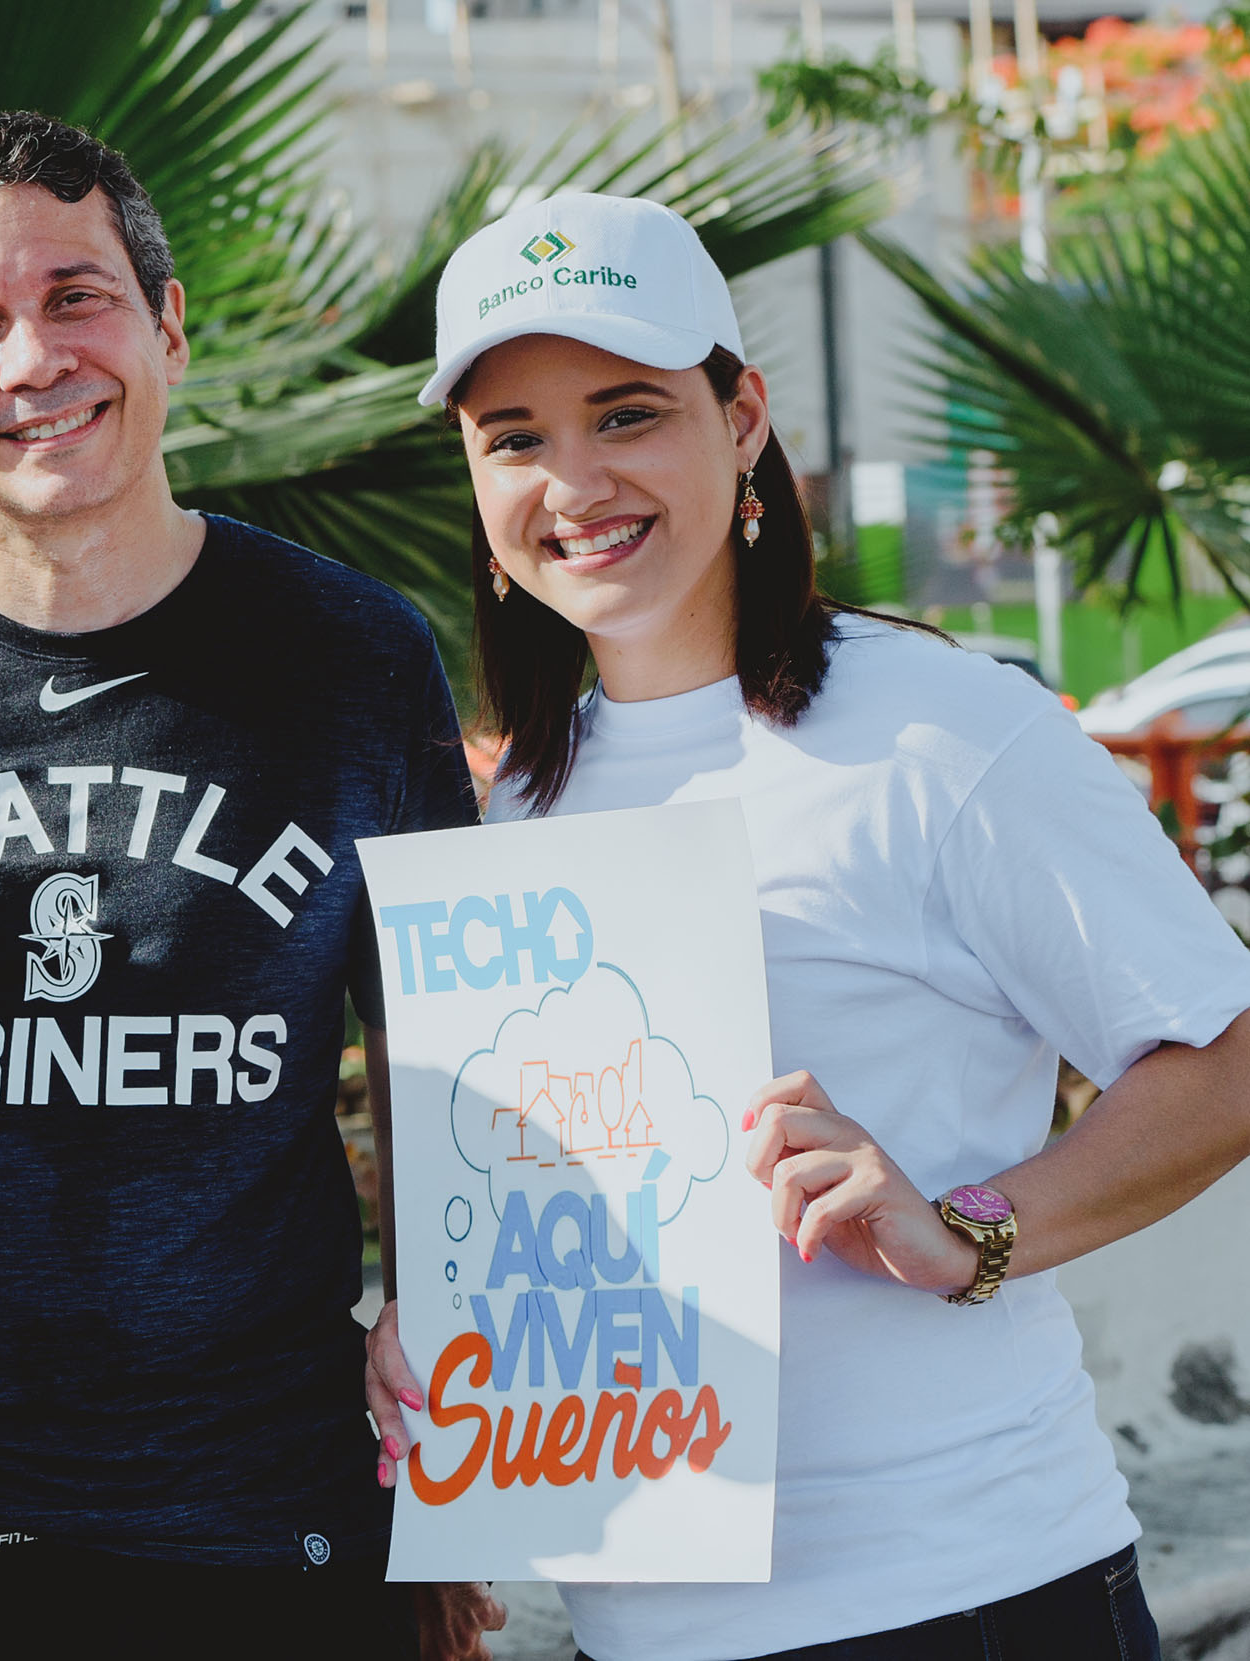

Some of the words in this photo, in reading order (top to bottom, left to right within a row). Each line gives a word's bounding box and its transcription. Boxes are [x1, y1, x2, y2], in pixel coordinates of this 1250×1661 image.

[478, 276, 543, 320] Banco
[553, 265, 637, 289] Caribe
[379, 886, 594, 995] TECHO
[486, 1148, 671, 1291] AQUÍ
[469, 1286, 699, 1392] VIVEN
[408, 1331, 732, 1506] Sueños
